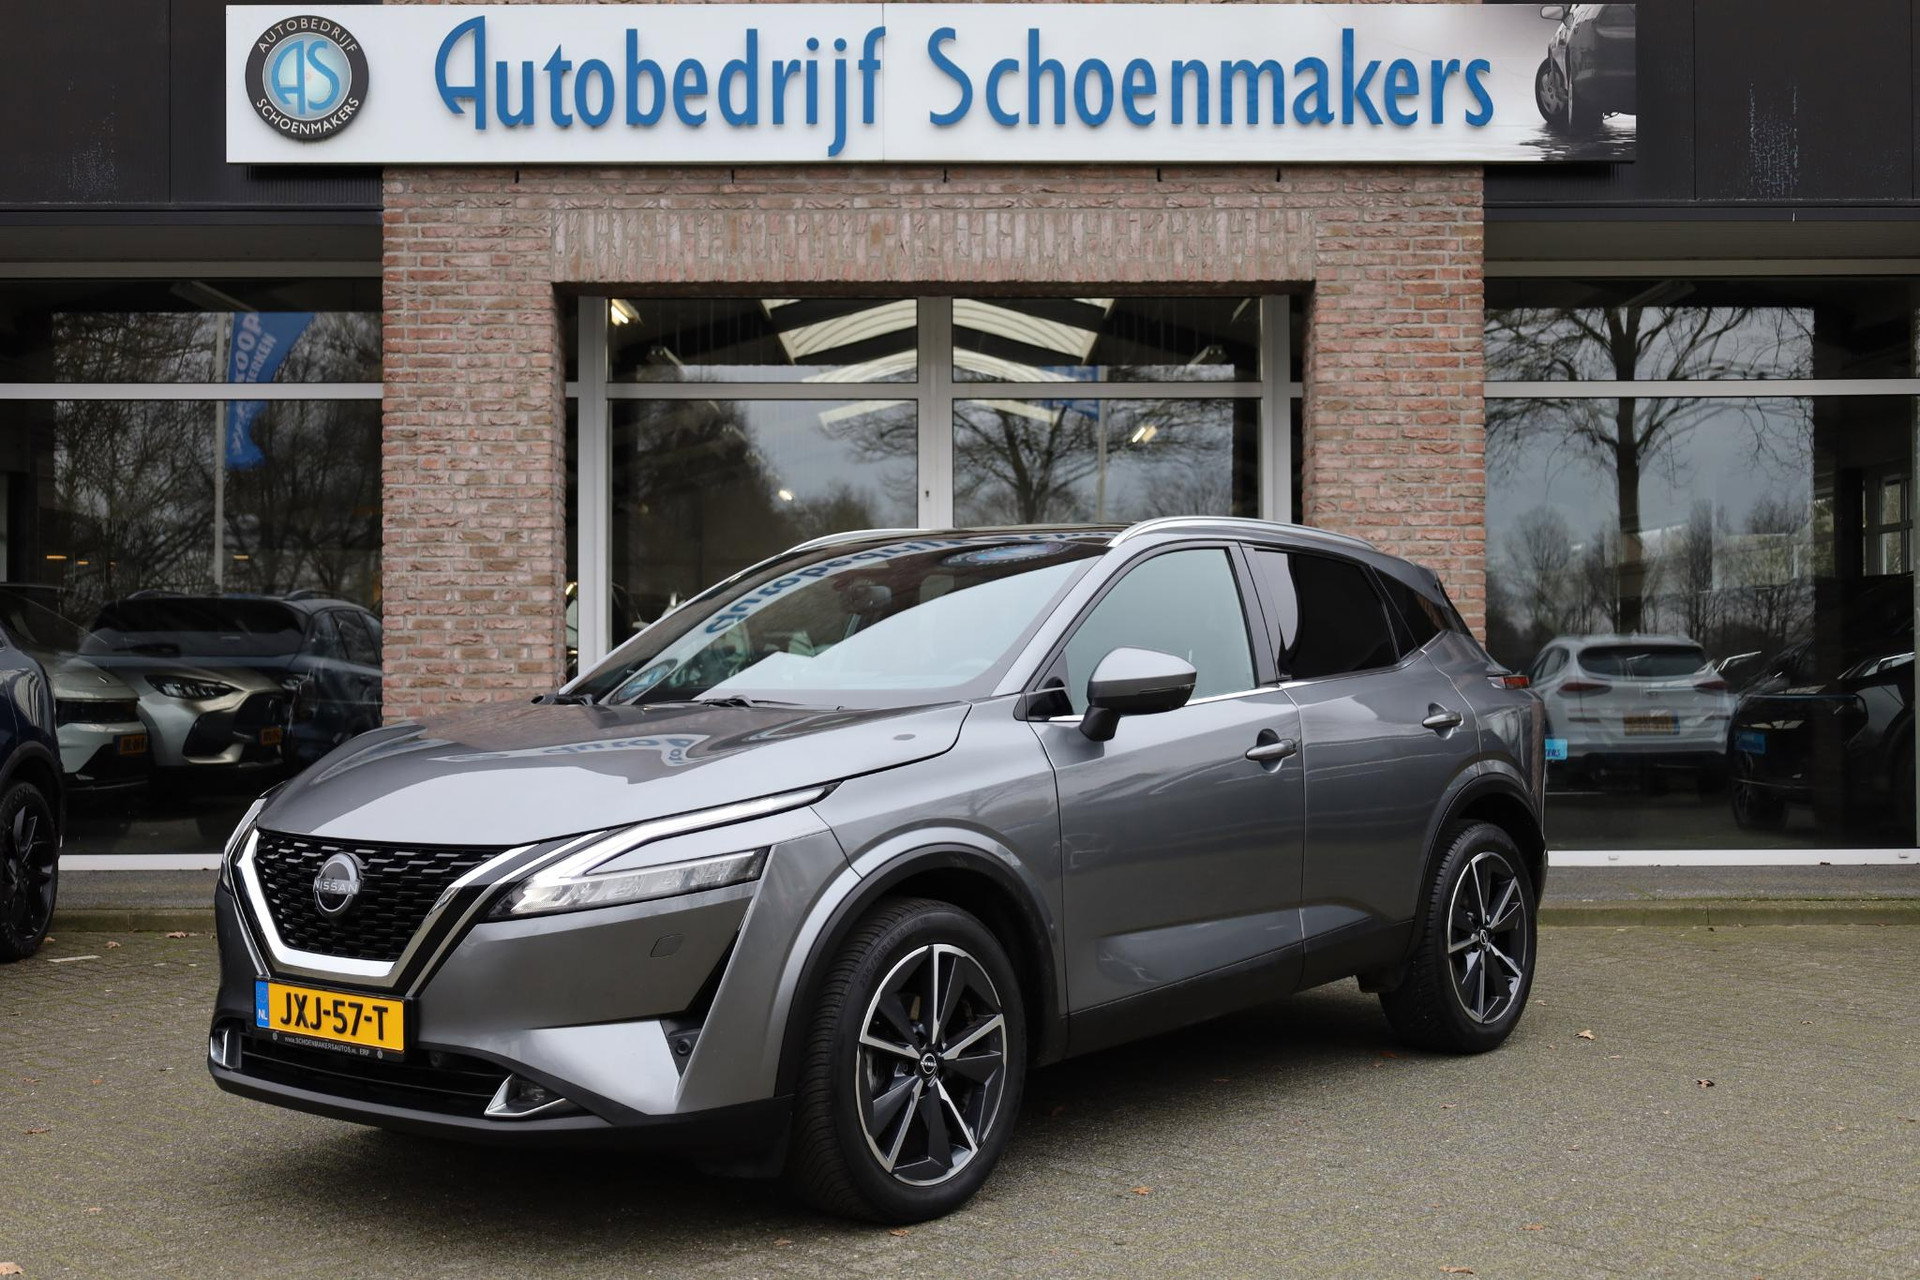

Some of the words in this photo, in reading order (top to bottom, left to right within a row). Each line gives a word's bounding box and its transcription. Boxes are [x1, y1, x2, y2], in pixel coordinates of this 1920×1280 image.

[258, 18, 358, 53] AUTOBEDRIJF
[271, 39, 340, 115] AS
[434, 14, 886, 158] Autobedrijf
[927, 26, 1495, 127] Schoenmakers
[256, 97, 360, 135] SCHOENMAKERS
[312, 878, 359, 894] NISSAN
[257, 1008, 268, 1021] NL
[280, 992, 389, 1041] JXJ-57-T
